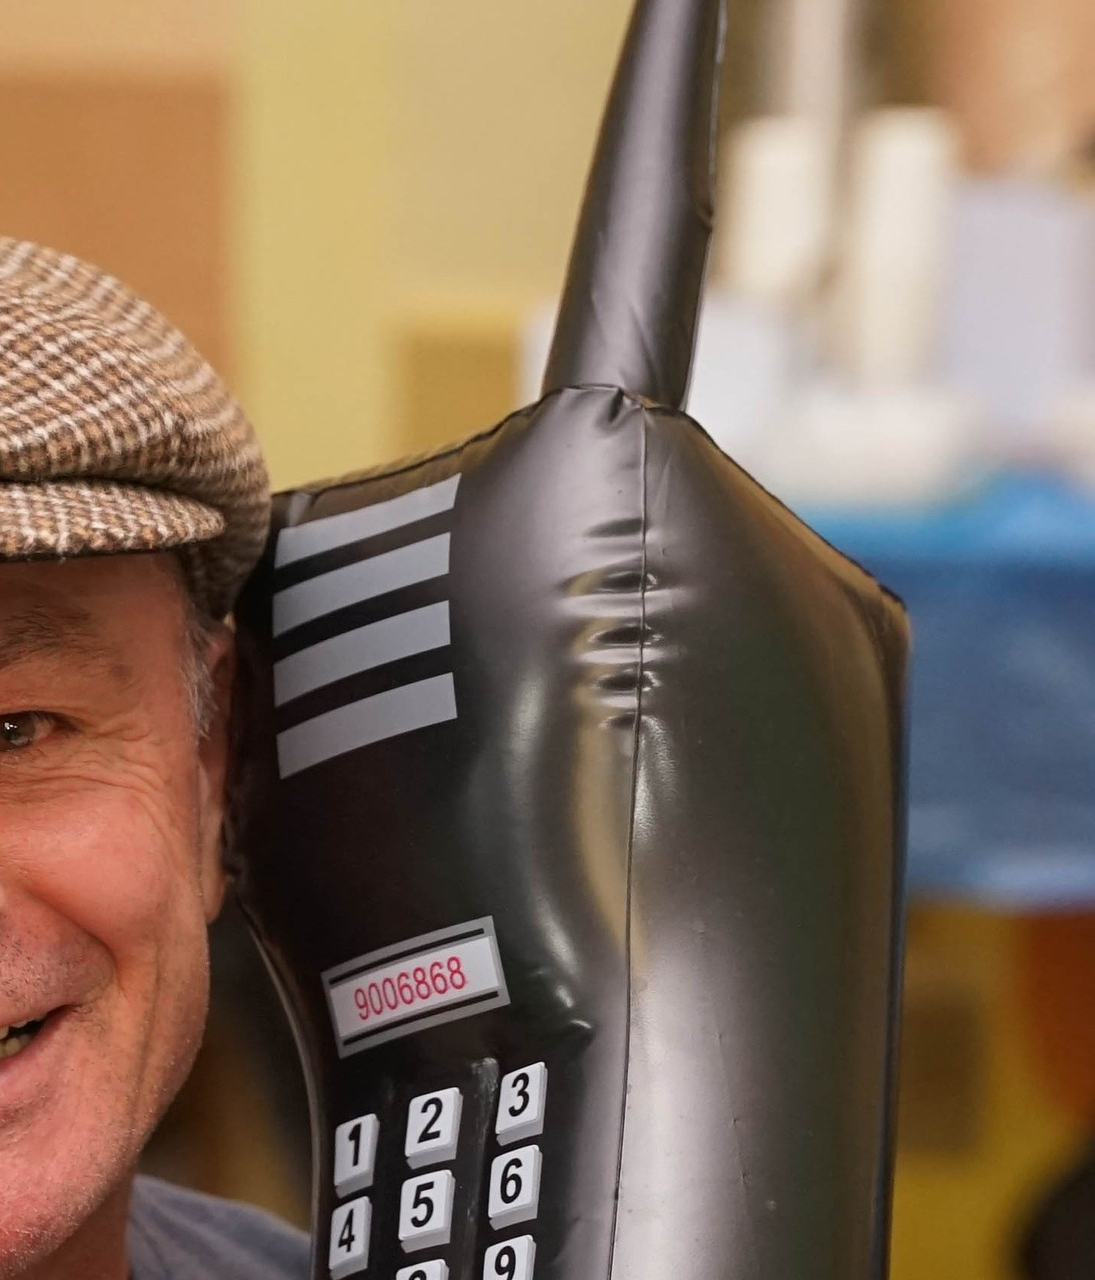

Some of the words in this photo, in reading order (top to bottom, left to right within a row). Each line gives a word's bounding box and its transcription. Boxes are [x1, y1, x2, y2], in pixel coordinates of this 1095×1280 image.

[353, 955, 467, 1021] 9006868
[347, 1122, 362, 1167] 1
[417, 1097, 443, 1144] 2
[508, 1072, 530, 1118] 3
[337, 1208, 356, 1253] 4
[410, 1180, 435, 1228] 5
[499, 1157, 523, 1205] 6
